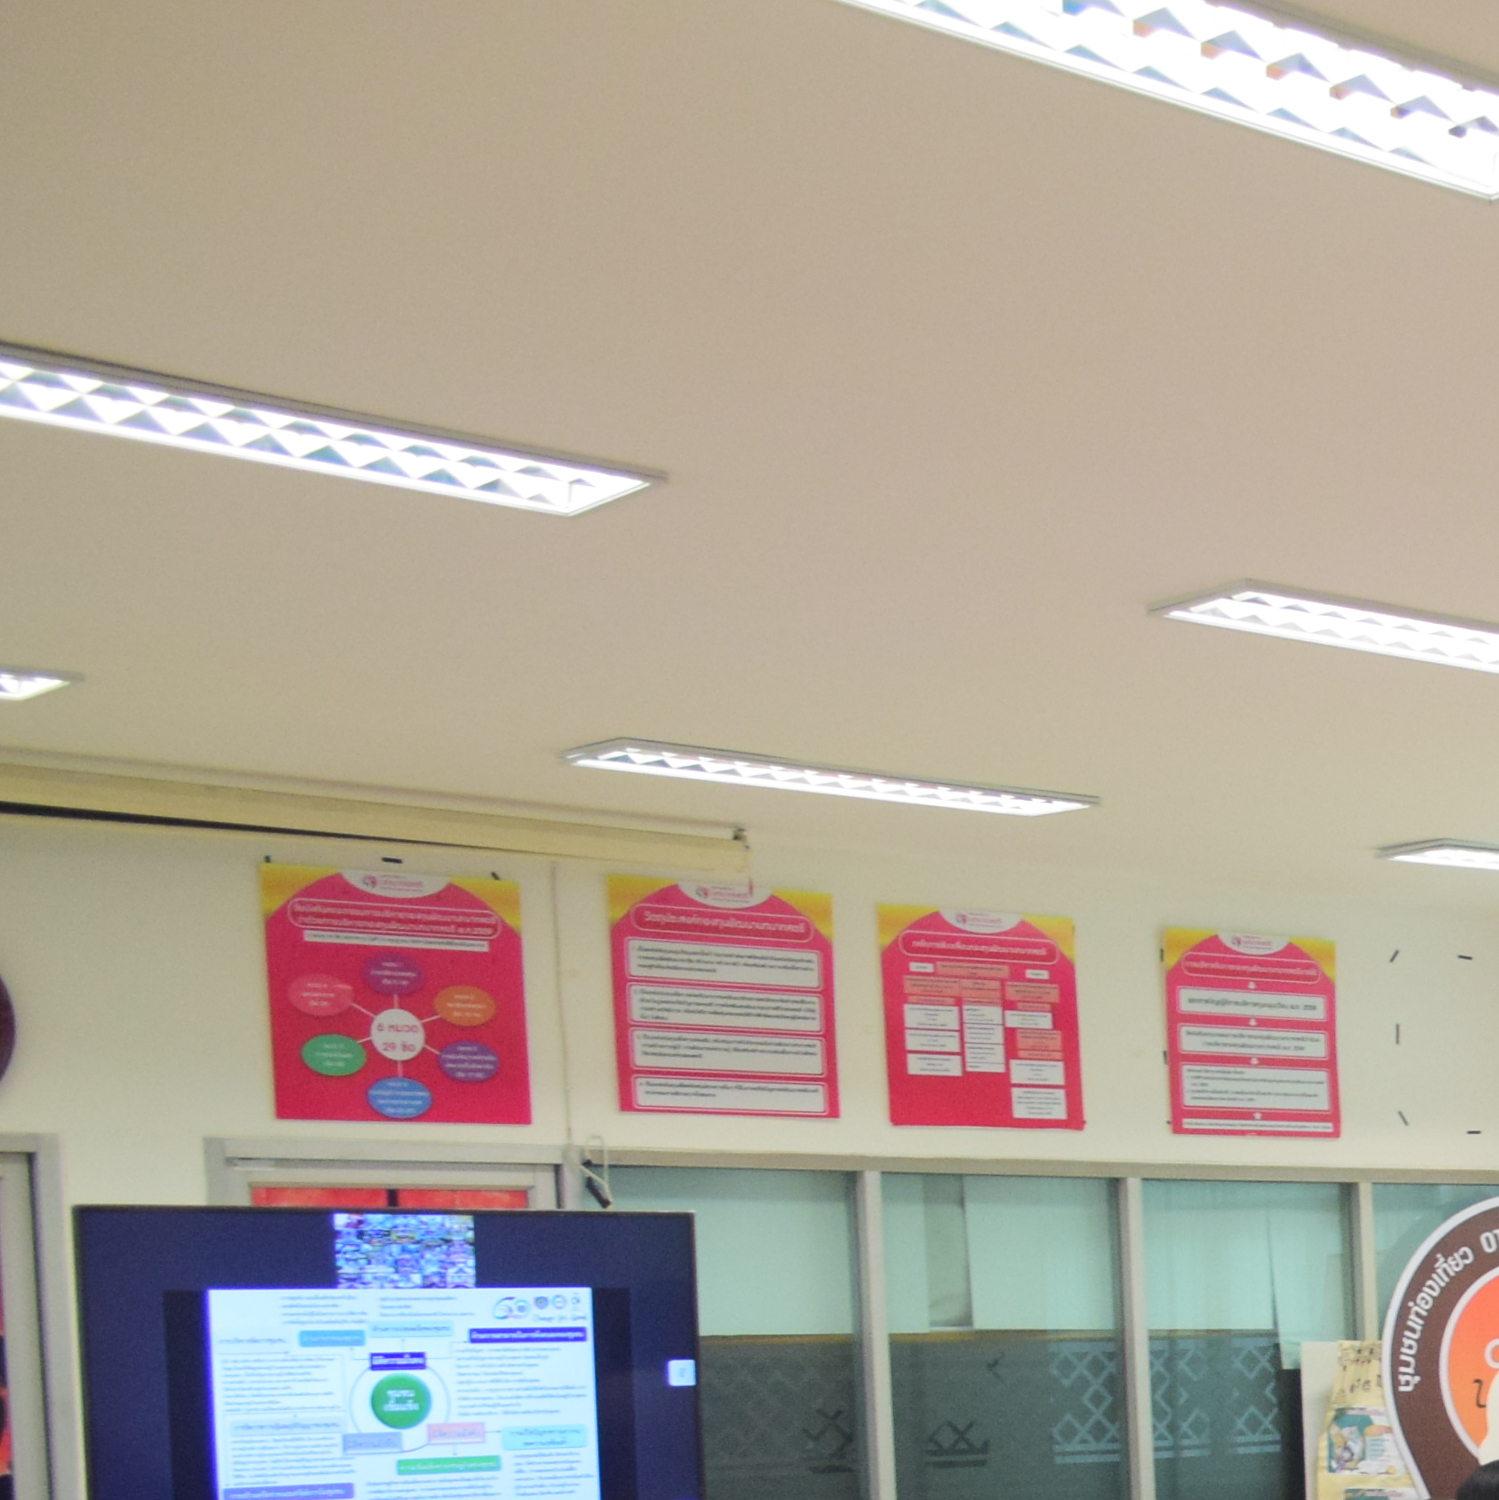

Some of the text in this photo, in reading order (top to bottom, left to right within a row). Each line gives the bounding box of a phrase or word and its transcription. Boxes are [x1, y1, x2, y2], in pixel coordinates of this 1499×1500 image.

[1398, 1246, 1475, 1392] ชุมชนท่องเที่ยว
